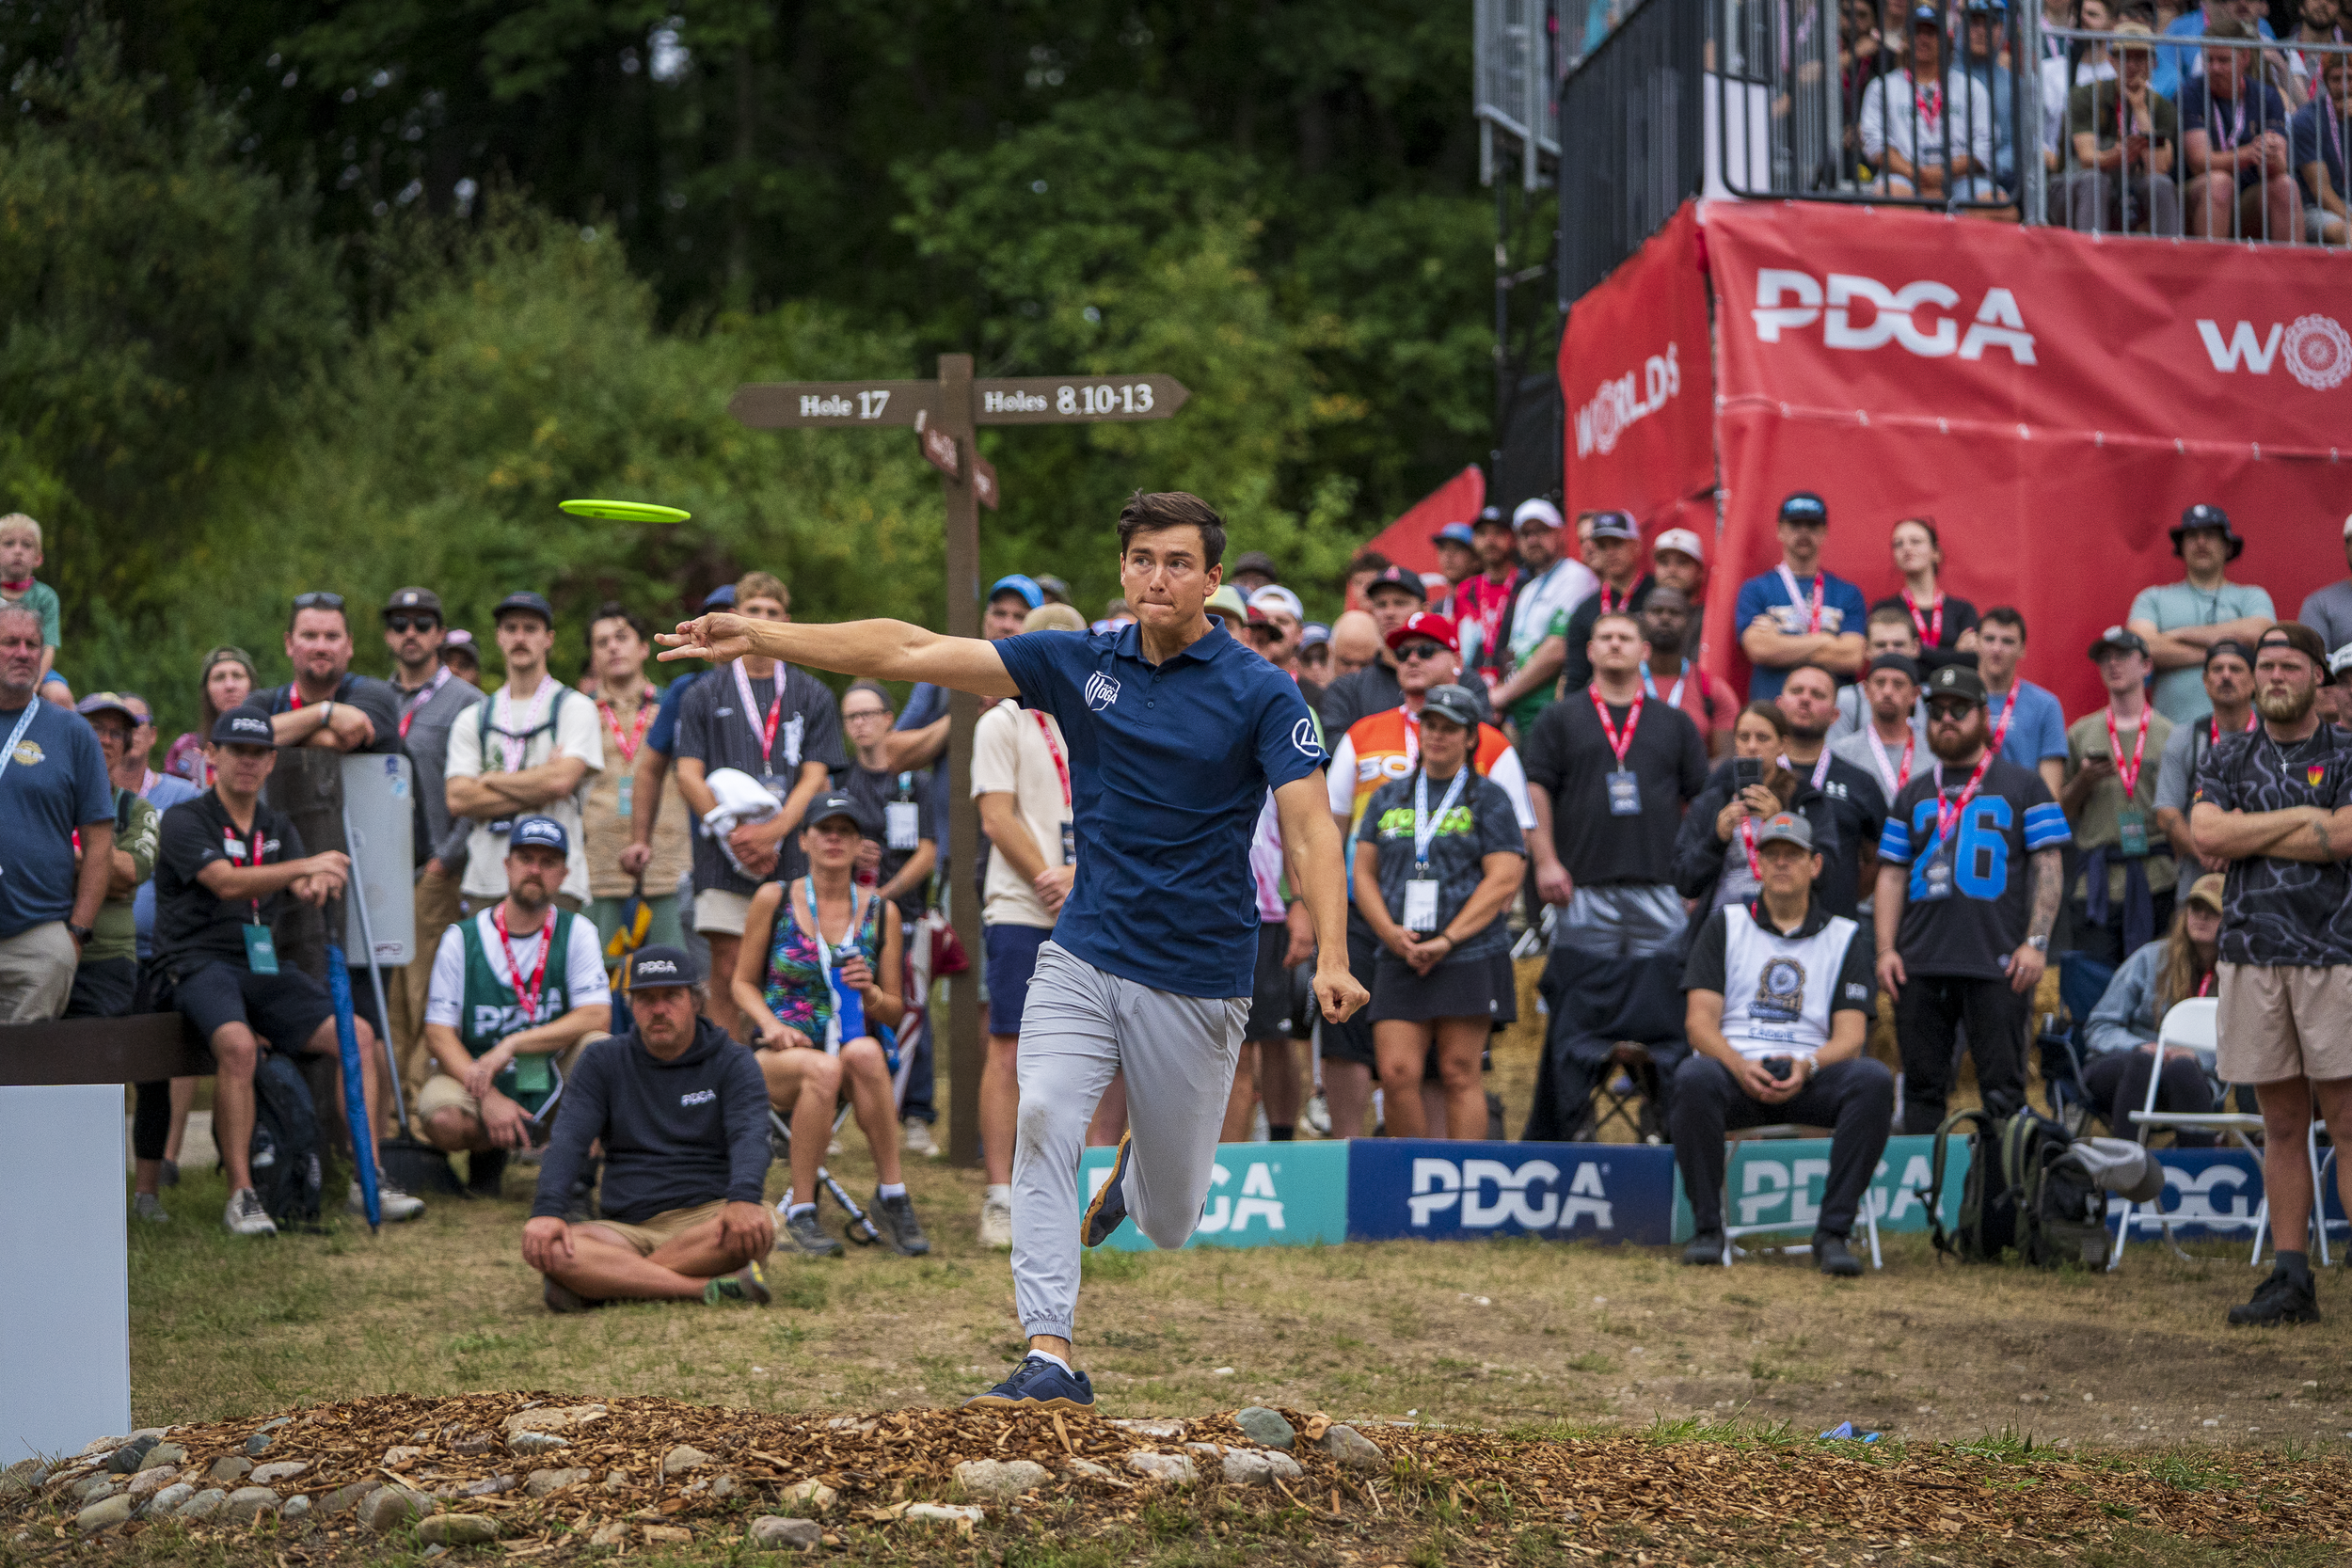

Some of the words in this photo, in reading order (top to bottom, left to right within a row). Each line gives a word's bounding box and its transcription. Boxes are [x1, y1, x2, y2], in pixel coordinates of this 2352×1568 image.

[1750, 266, 2039, 367] PDGA
[799, 393, 853, 417] Hole
[856, 389, 891, 420] 17
[983, 389, 1049, 413] Holes
[1909, 795, 2013, 903] 26
[637, 959, 678, 975] PDGA
[680, 1088, 717, 1108] PDGA
[1406, 1157, 1615, 1229] PDGA
